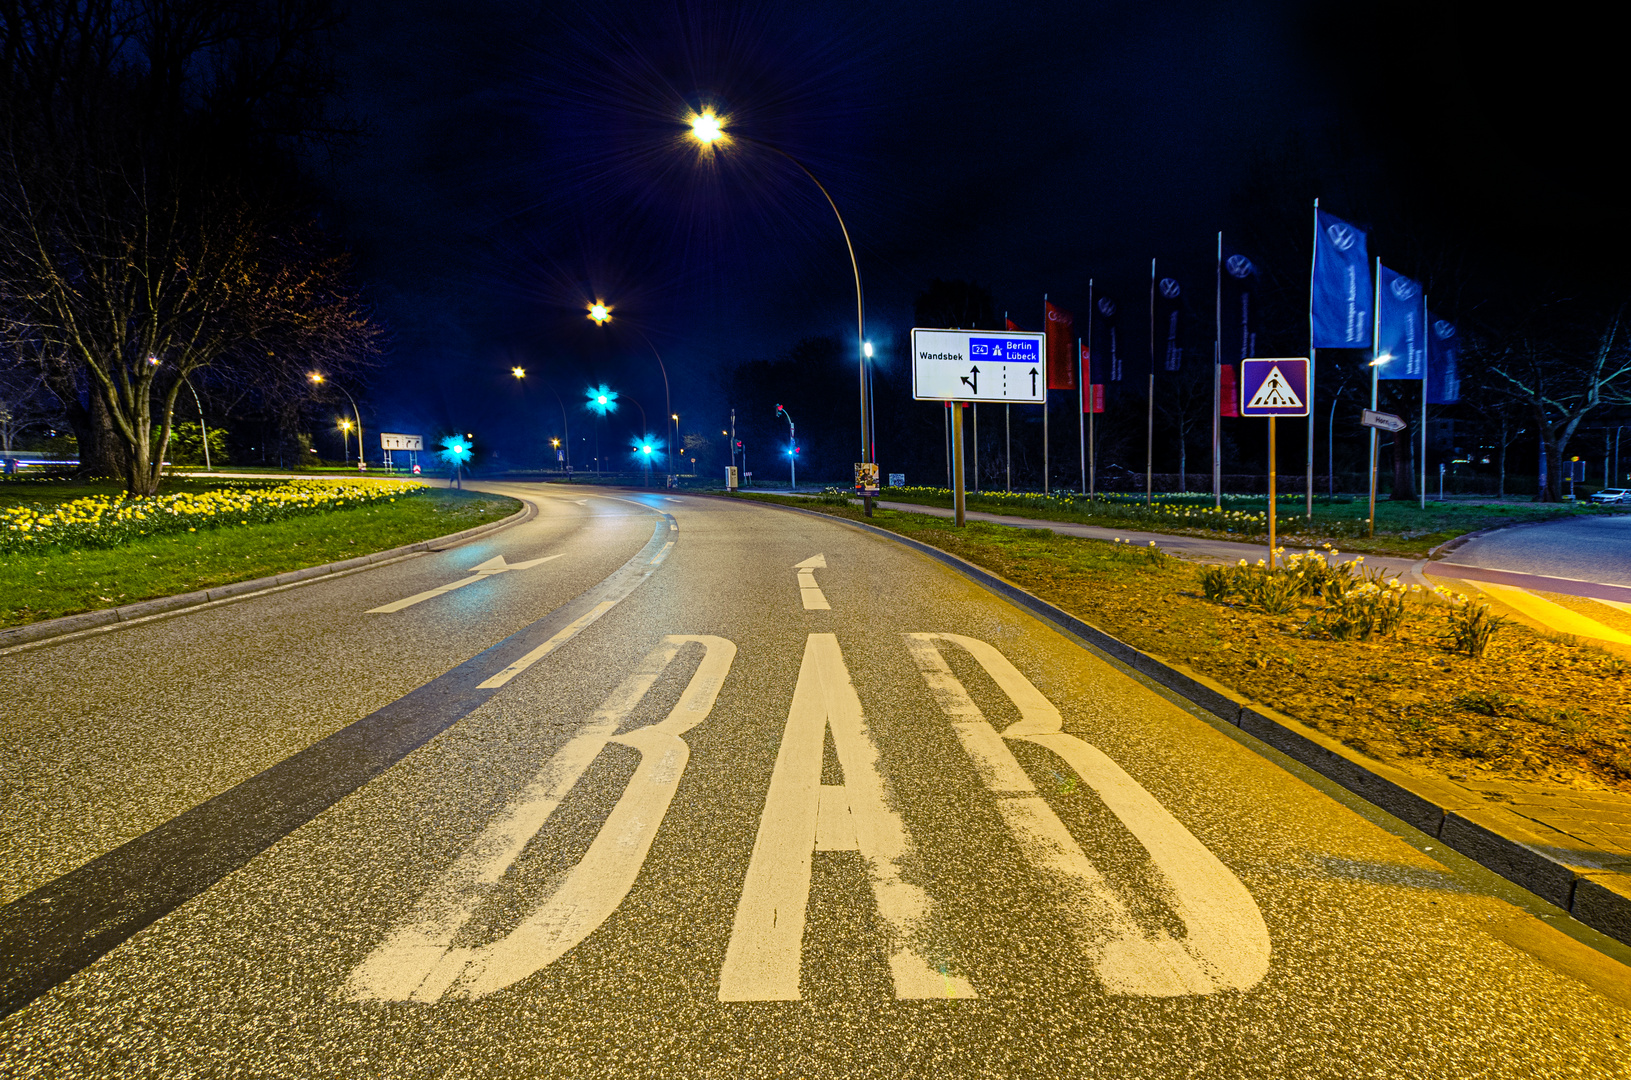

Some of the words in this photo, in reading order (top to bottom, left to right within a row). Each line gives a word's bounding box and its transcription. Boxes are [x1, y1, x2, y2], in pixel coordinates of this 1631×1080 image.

[1006, 341, 1032, 350] Berlin
[919, 351, 963, 361] Wandsbek
[1006, 351, 1037, 361] Lübeck
